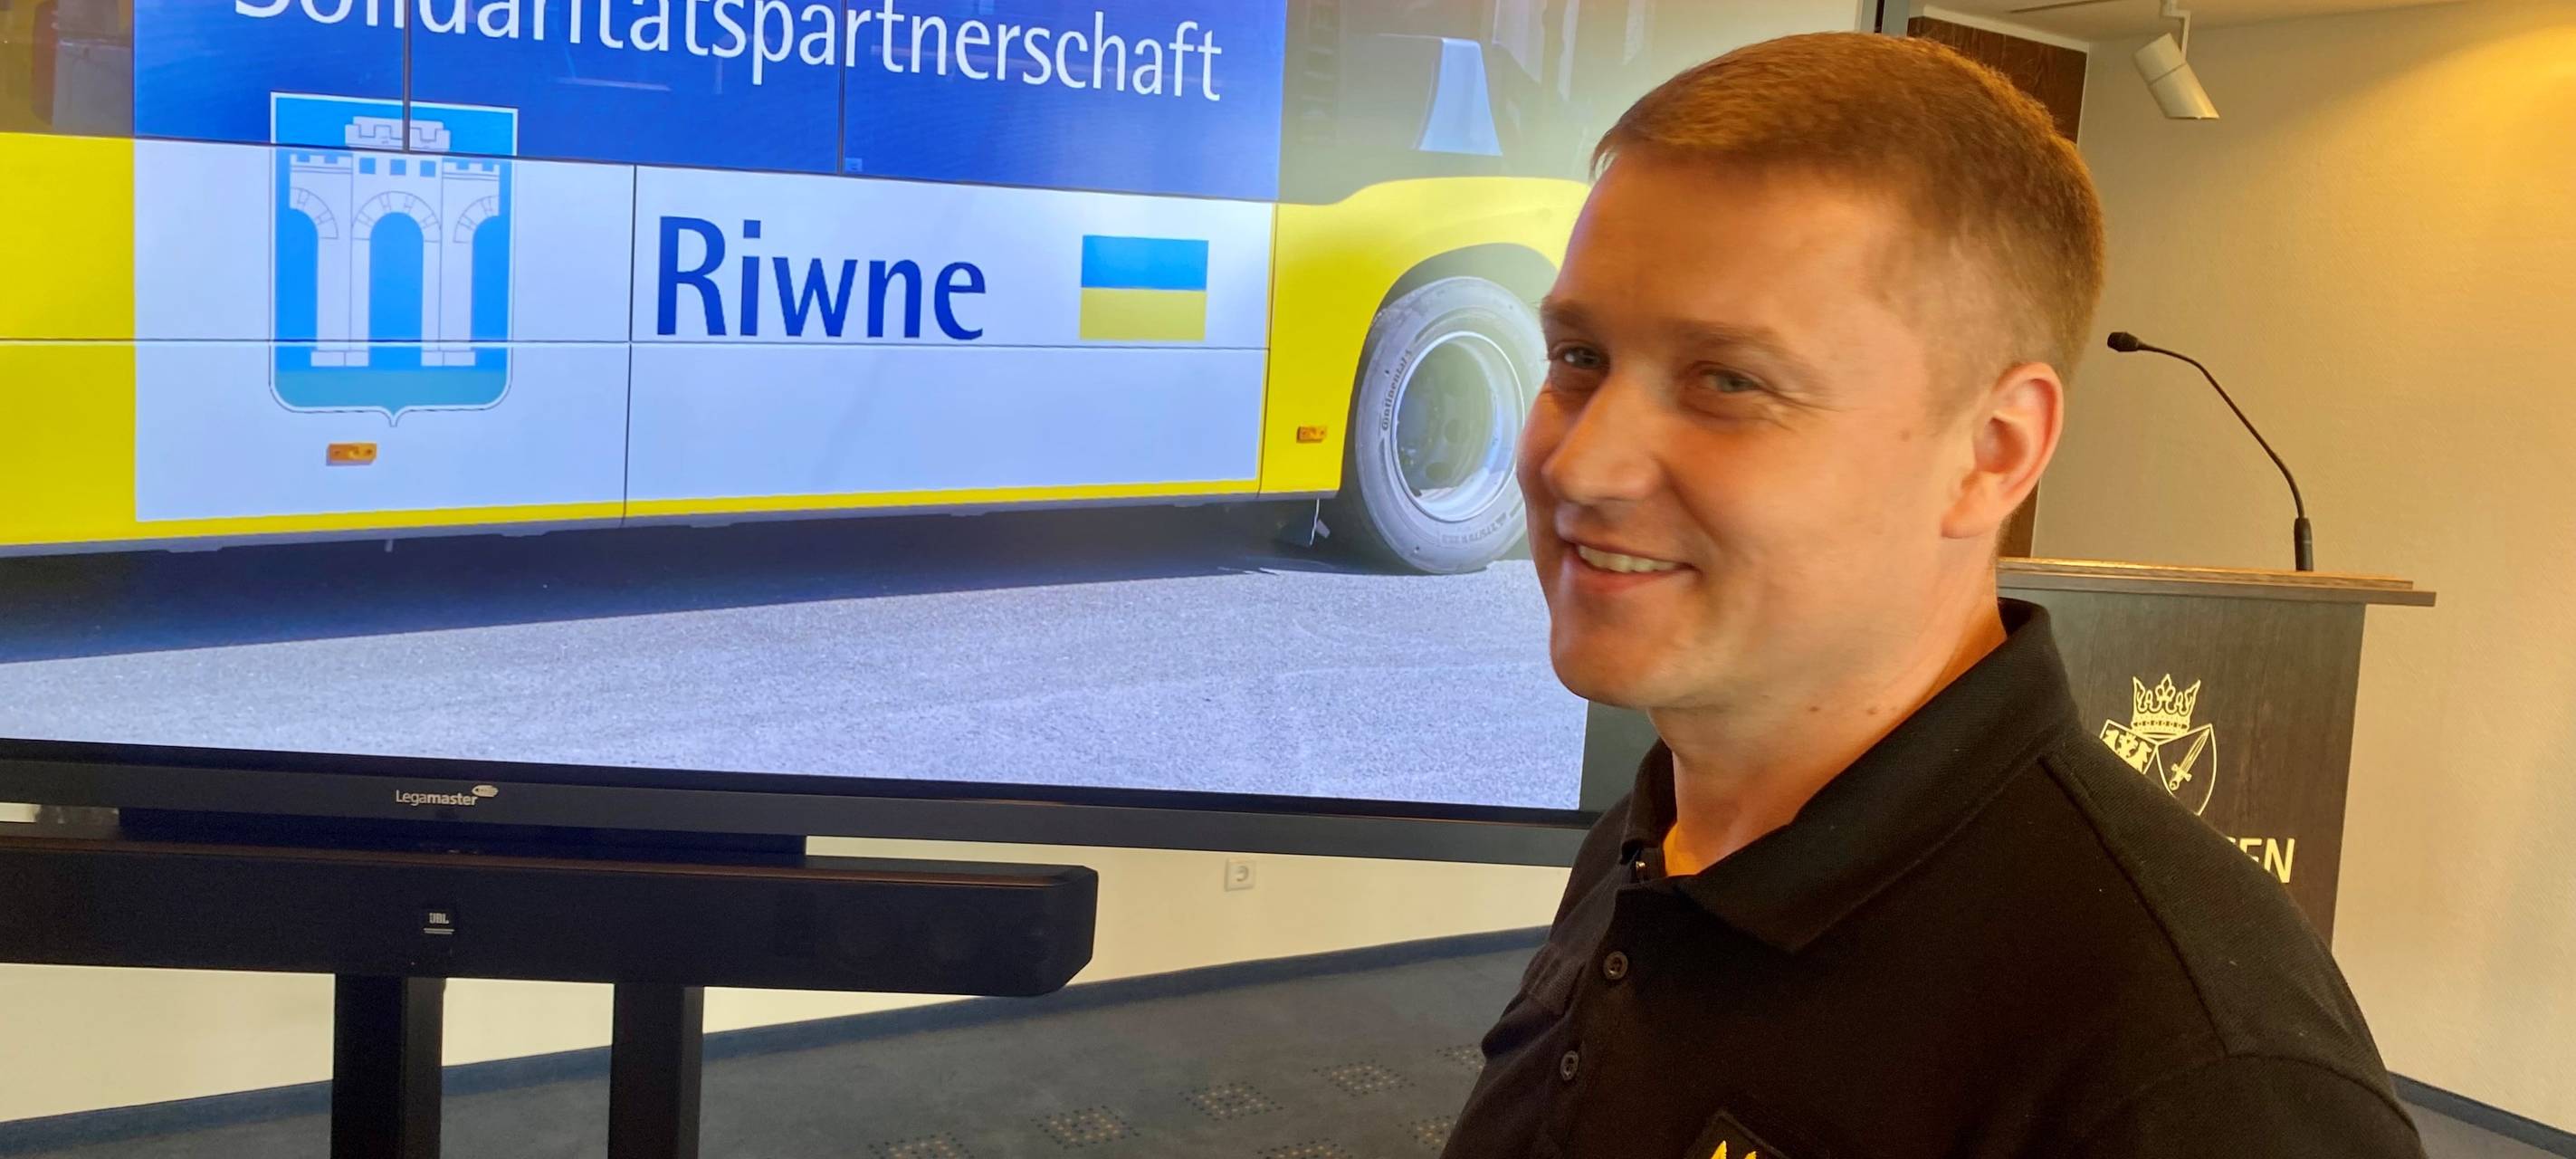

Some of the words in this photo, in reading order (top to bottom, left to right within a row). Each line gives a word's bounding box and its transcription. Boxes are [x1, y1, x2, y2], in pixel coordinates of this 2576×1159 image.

[235, 0, 1222, 101] aitätspartnerschaft
[657, 216, 986, 340] Riwne
[396, 789, 478, 806] Legamaster
[429, 912, 450, 924] JBL
